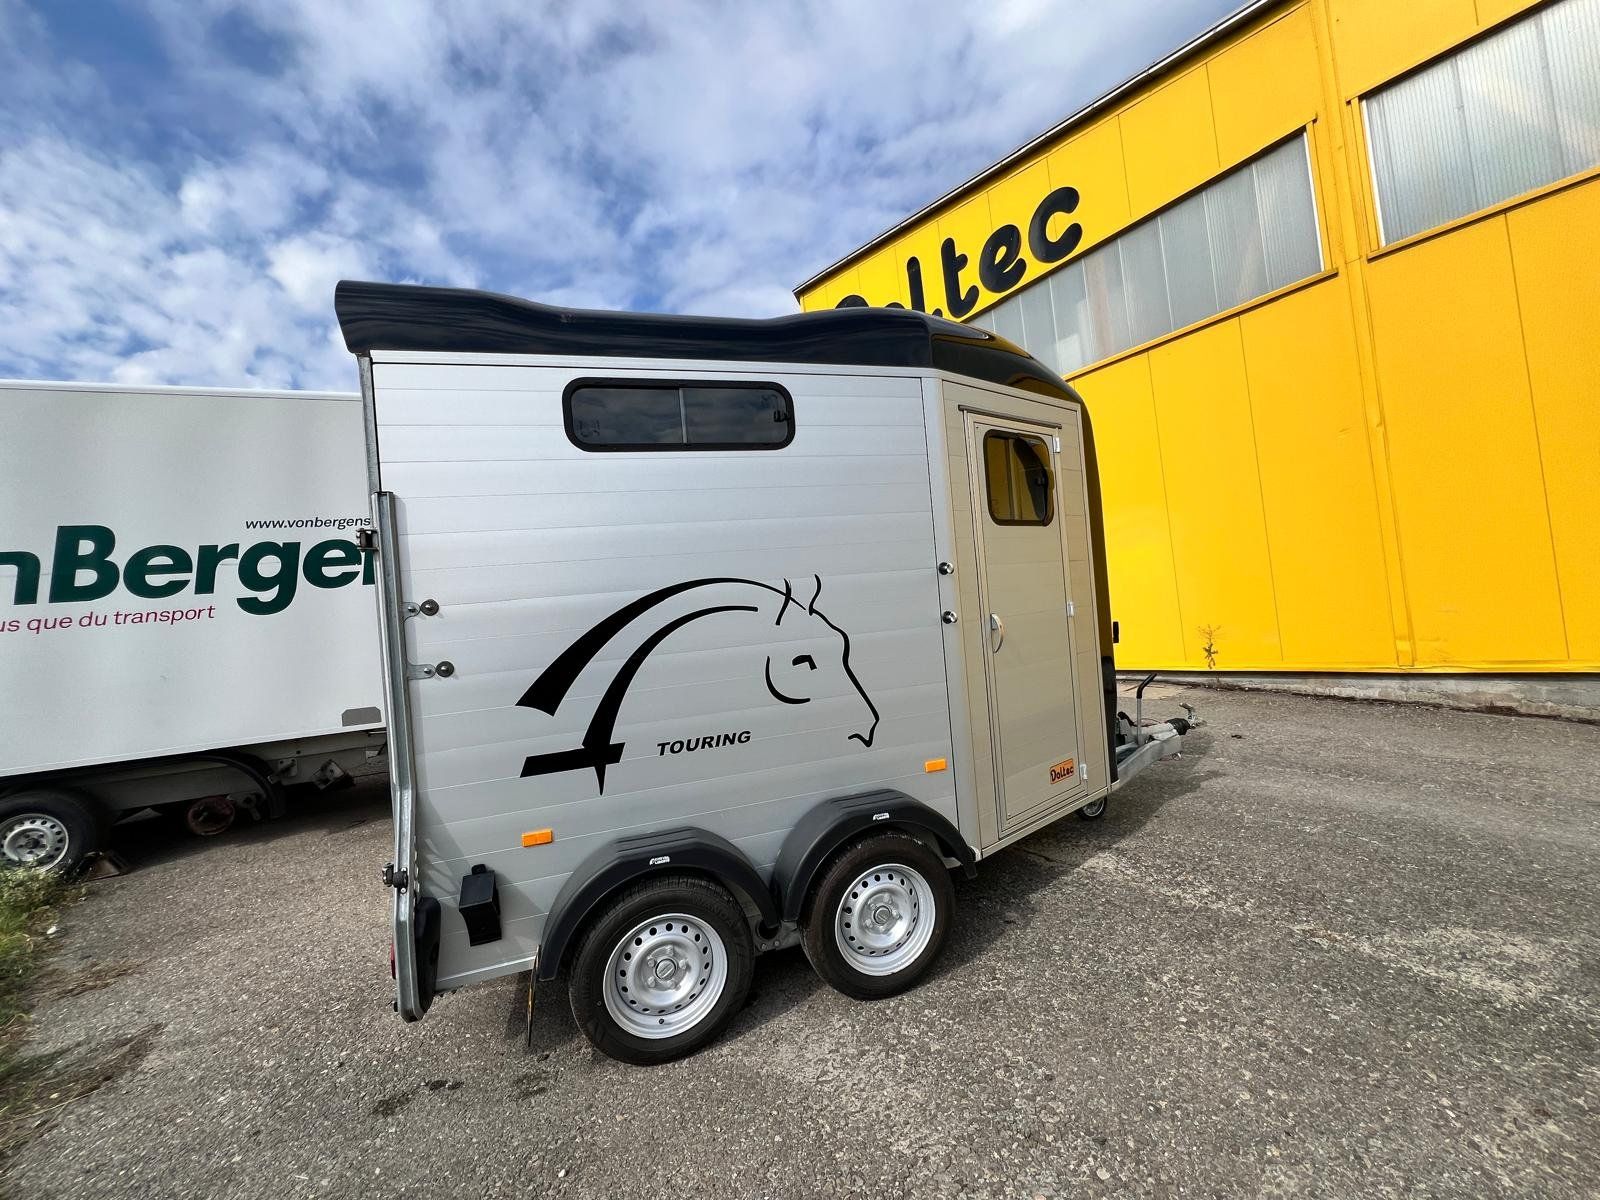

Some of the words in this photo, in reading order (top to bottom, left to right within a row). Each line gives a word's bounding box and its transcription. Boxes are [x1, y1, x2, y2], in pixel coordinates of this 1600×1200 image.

[835, 186, 1083, 318] ltec
[27, 616, 73, 634] que
[79, 611, 108, 628] du
[113, 605, 216, 625] transport
[656, 730, 752, 756] TOURING
[1050, 766, 1075, 782] Doltec
